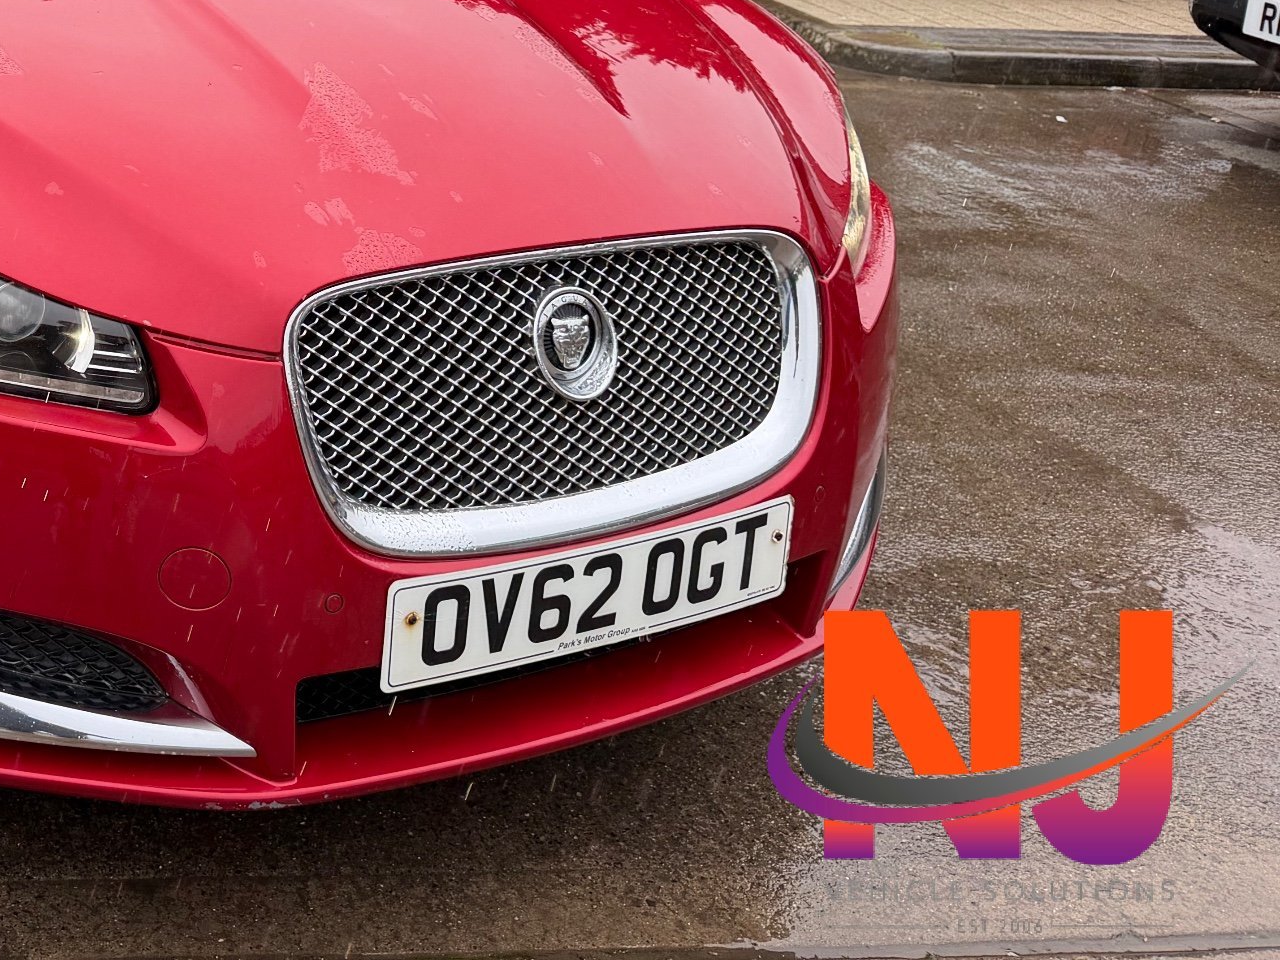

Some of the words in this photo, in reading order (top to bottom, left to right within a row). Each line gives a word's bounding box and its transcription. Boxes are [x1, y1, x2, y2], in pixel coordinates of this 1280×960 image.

[421, 553, 623, 667] OV62
[641, 513, 768, 617] OGT
[558, 638, 582, 651] Park's
[583, 632, 606, 645] Motor
[607, 627, 631, 639] Group
